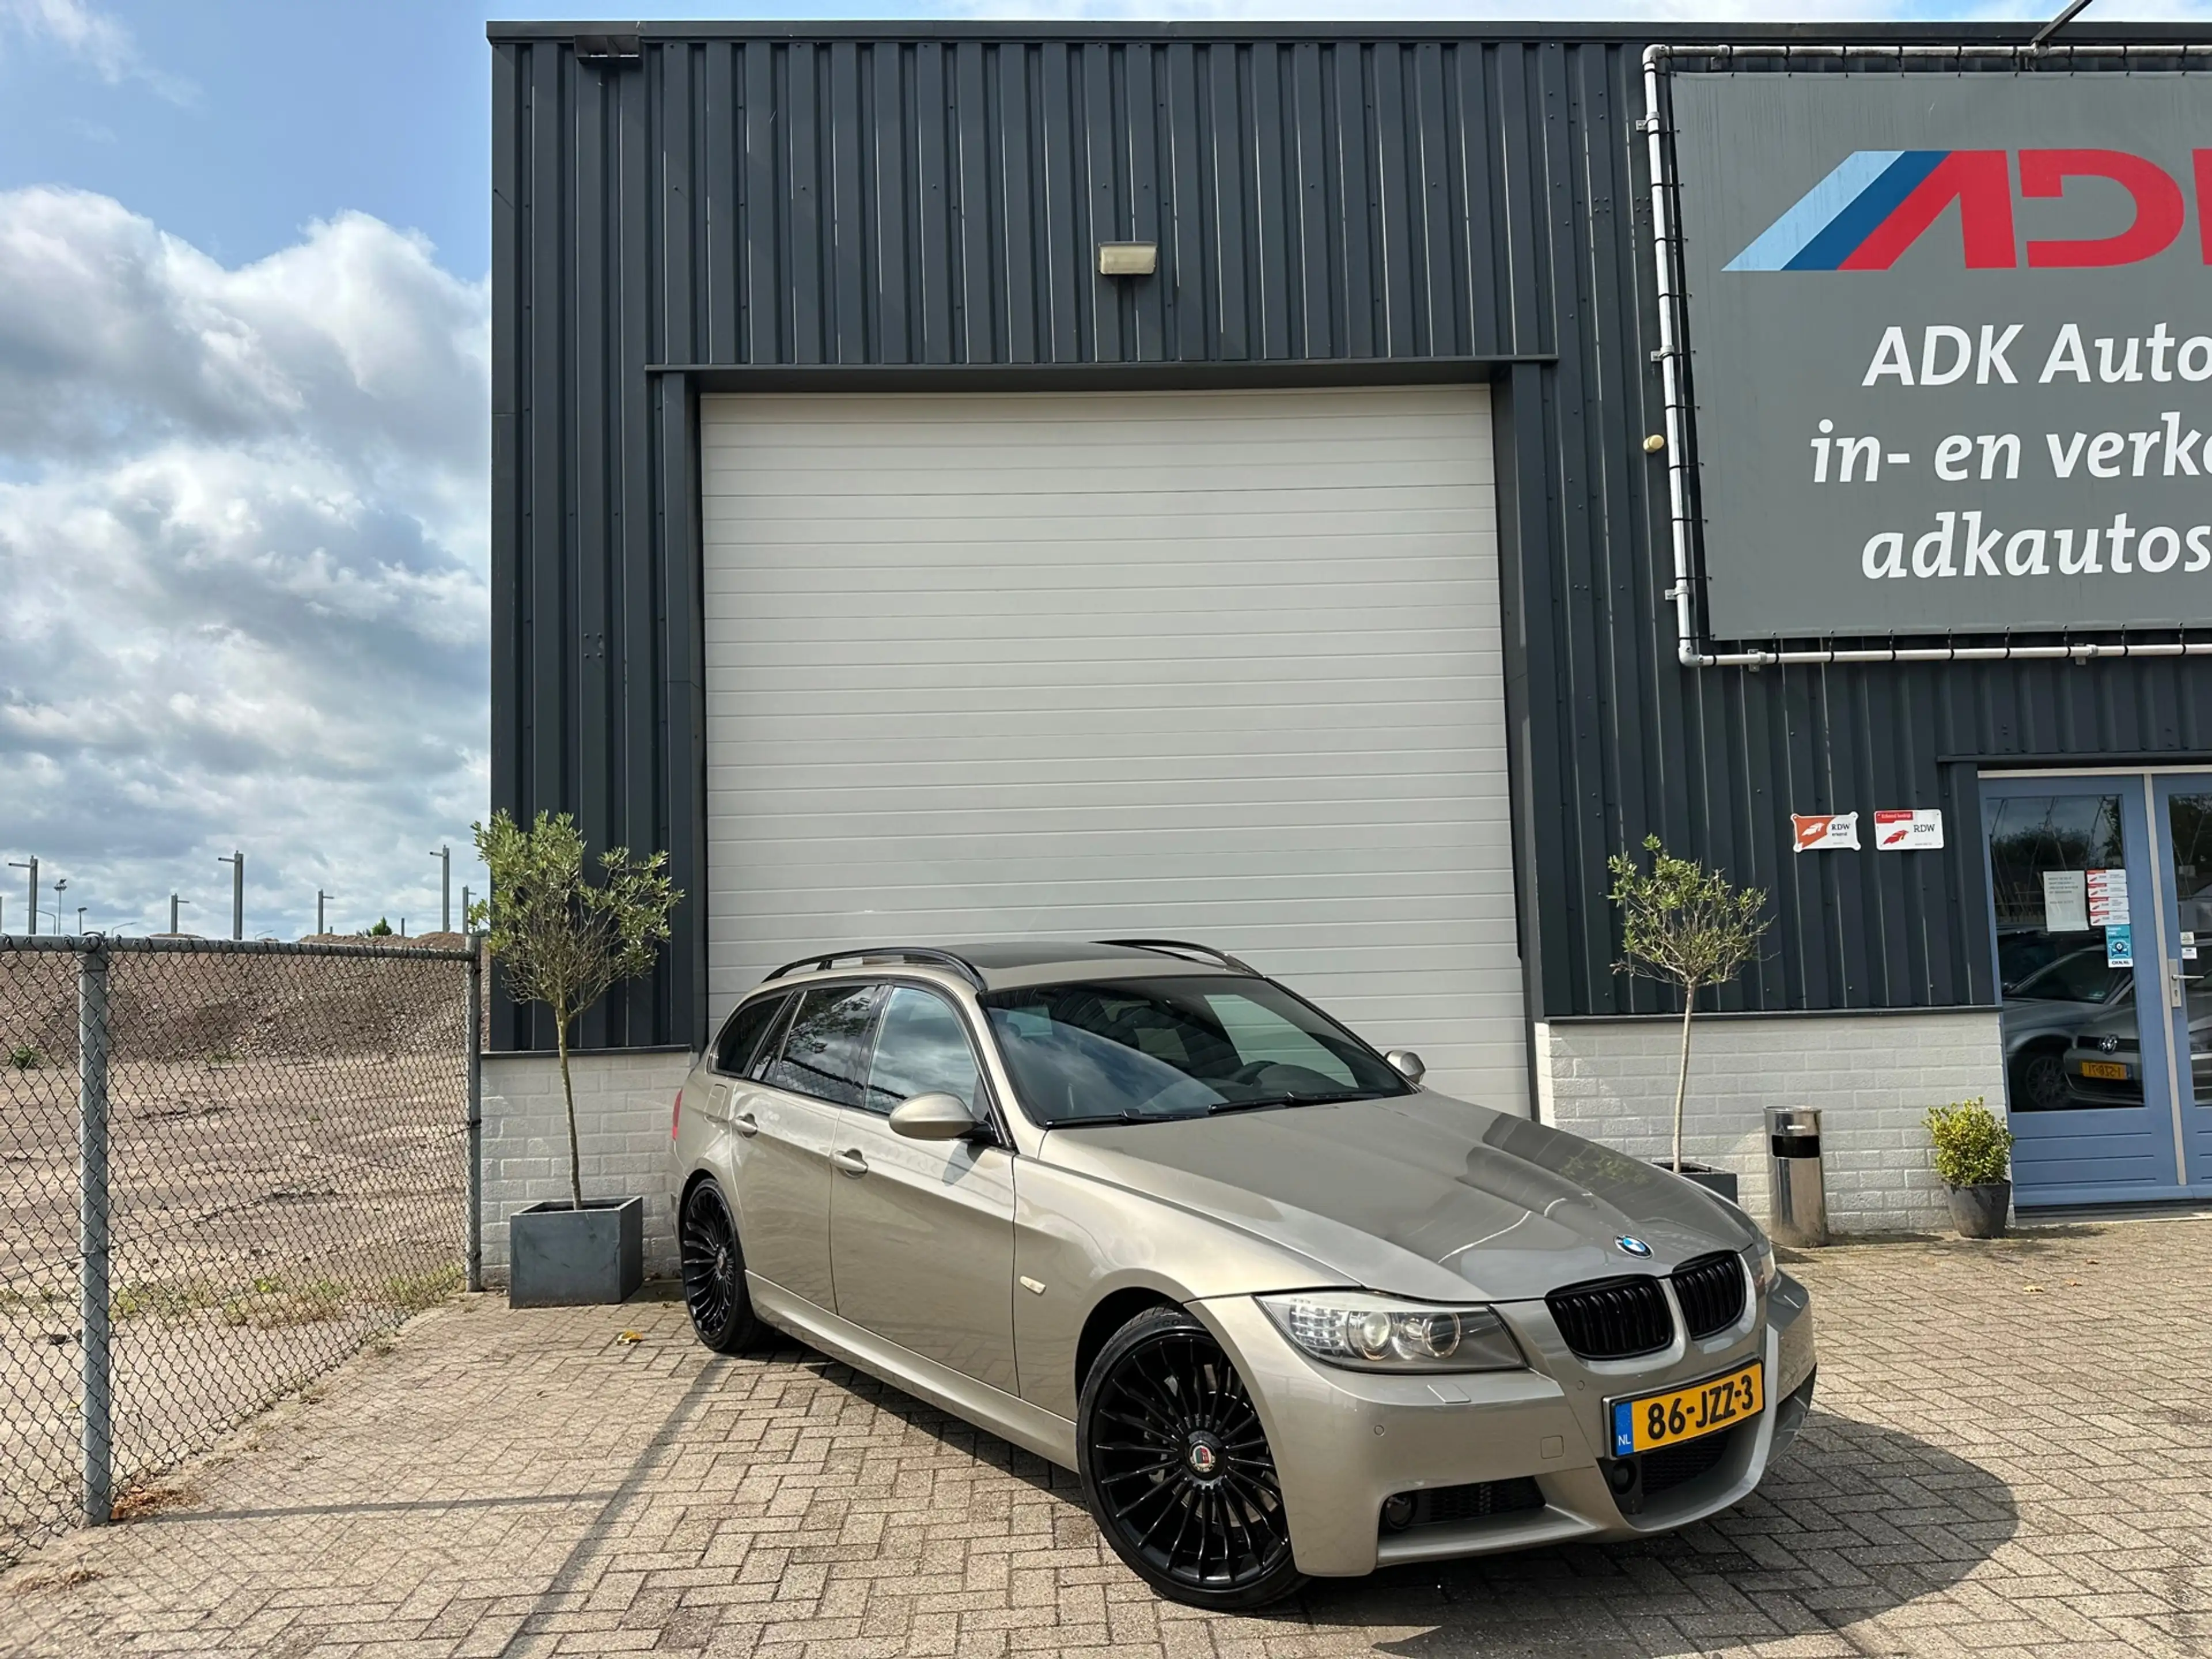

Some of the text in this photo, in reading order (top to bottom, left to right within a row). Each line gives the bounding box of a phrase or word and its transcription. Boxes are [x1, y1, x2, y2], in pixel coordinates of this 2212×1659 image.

[1836, 148, 2212, 271] AD
[1862, 323, 2212, 386] ADK Auto
[1811, 411, 2212, 483] in- en verk
[1862, 511, 2211, 579] adkautos
[1913, 824, 1936, 833] RDW
[1618, 1434, 1631, 1445] NL
[1647, 1374, 1754, 1440] 86-JZZ-3
